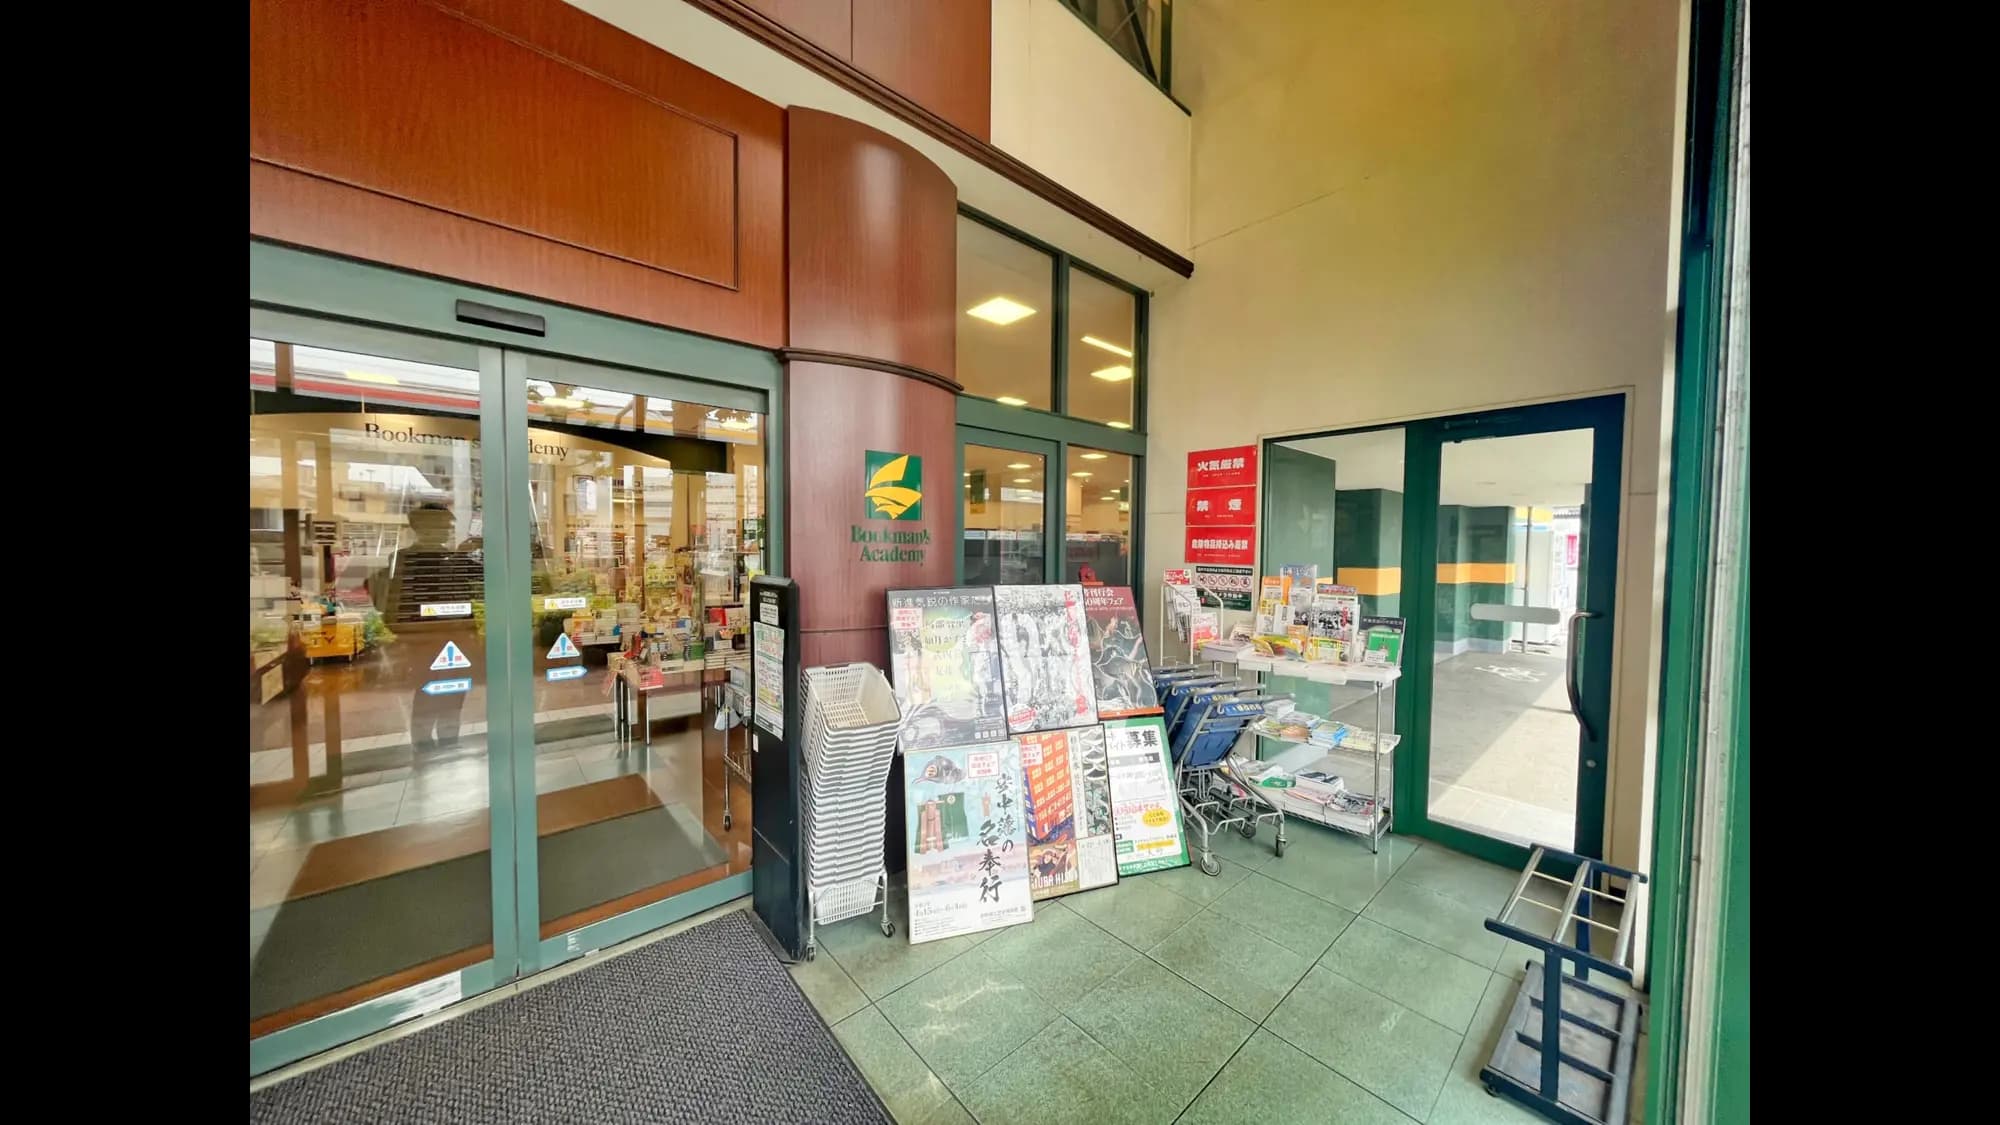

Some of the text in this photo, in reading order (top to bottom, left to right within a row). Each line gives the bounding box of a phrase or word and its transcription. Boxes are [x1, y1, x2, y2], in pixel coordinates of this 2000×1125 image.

[364, 422, 481, 448] Bookmans
[1197, 458, 1245, 471] 火気厳禁
[851, 525, 930, 545] Bookman's
[860, 546, 925, 567] Academy
[1084, 597, 1124, 606] 0周年フェア
[1126, 730, 1159, 747] 募集
[996, 773, 1017, 853] 安中藩の
[976, 819, 1003, 903] 名奉行
